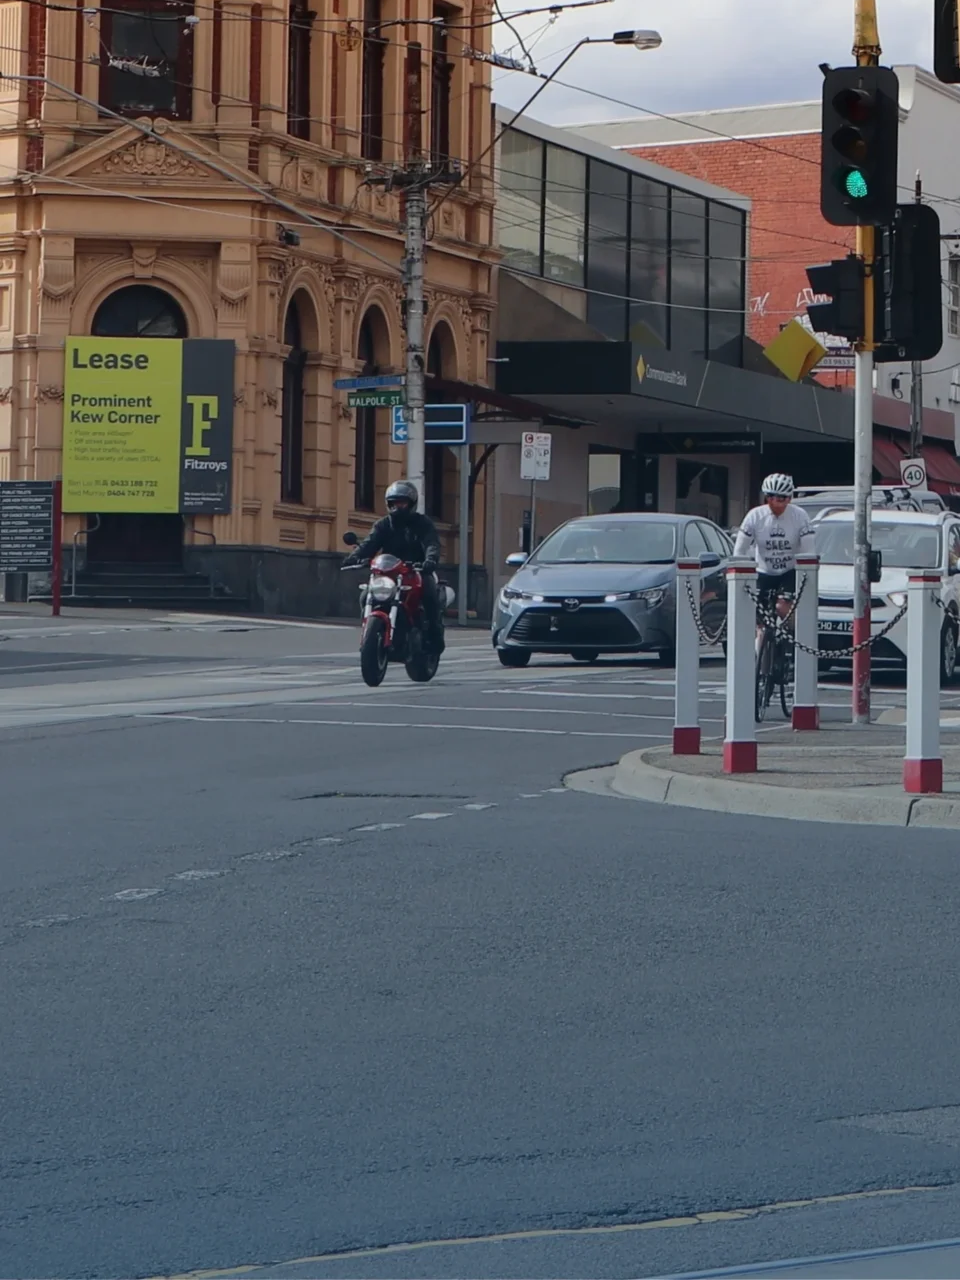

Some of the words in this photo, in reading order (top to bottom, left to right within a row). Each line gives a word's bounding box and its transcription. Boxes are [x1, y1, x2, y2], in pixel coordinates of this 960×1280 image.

[72, 347, 150, 370] Lease
[70, 393, 153, 408] Prominent
[349, 395, 386, 407] WALPOLE
[390, 395, 400, 405] ST
[70, 410, 104, 423] Kew
[107, 410, 161, 424] Corner
[185, 395, 219, 456] F
[184, 458, 228, 473] Fitzroys
[906, 469, 922, 481] 40
[765, 539, 791, 548] KEEP
